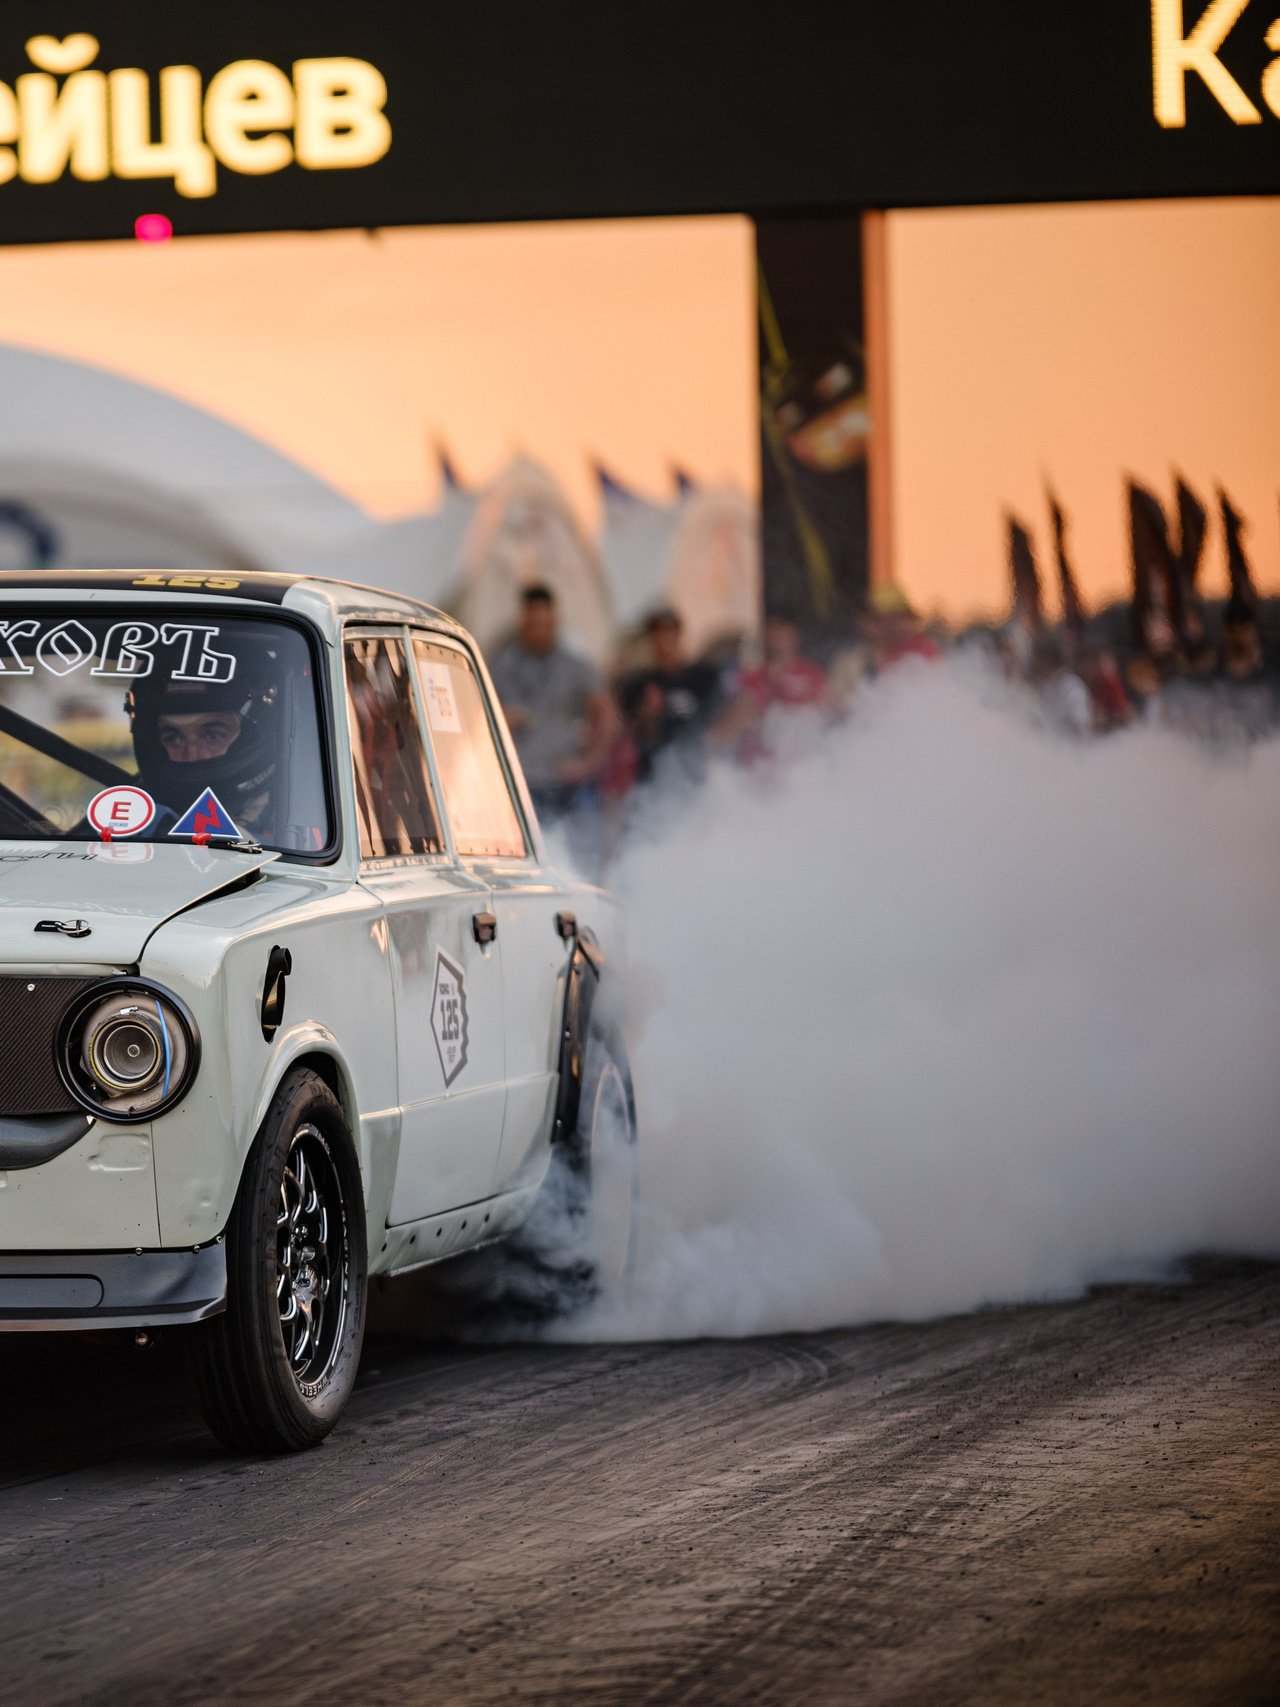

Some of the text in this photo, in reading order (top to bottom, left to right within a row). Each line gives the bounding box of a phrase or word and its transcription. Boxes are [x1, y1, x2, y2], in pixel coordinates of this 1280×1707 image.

[132, 574, 244, 590] 125
[111, 802, 131, 820] E
[440, 998, 459, 1041] 125
